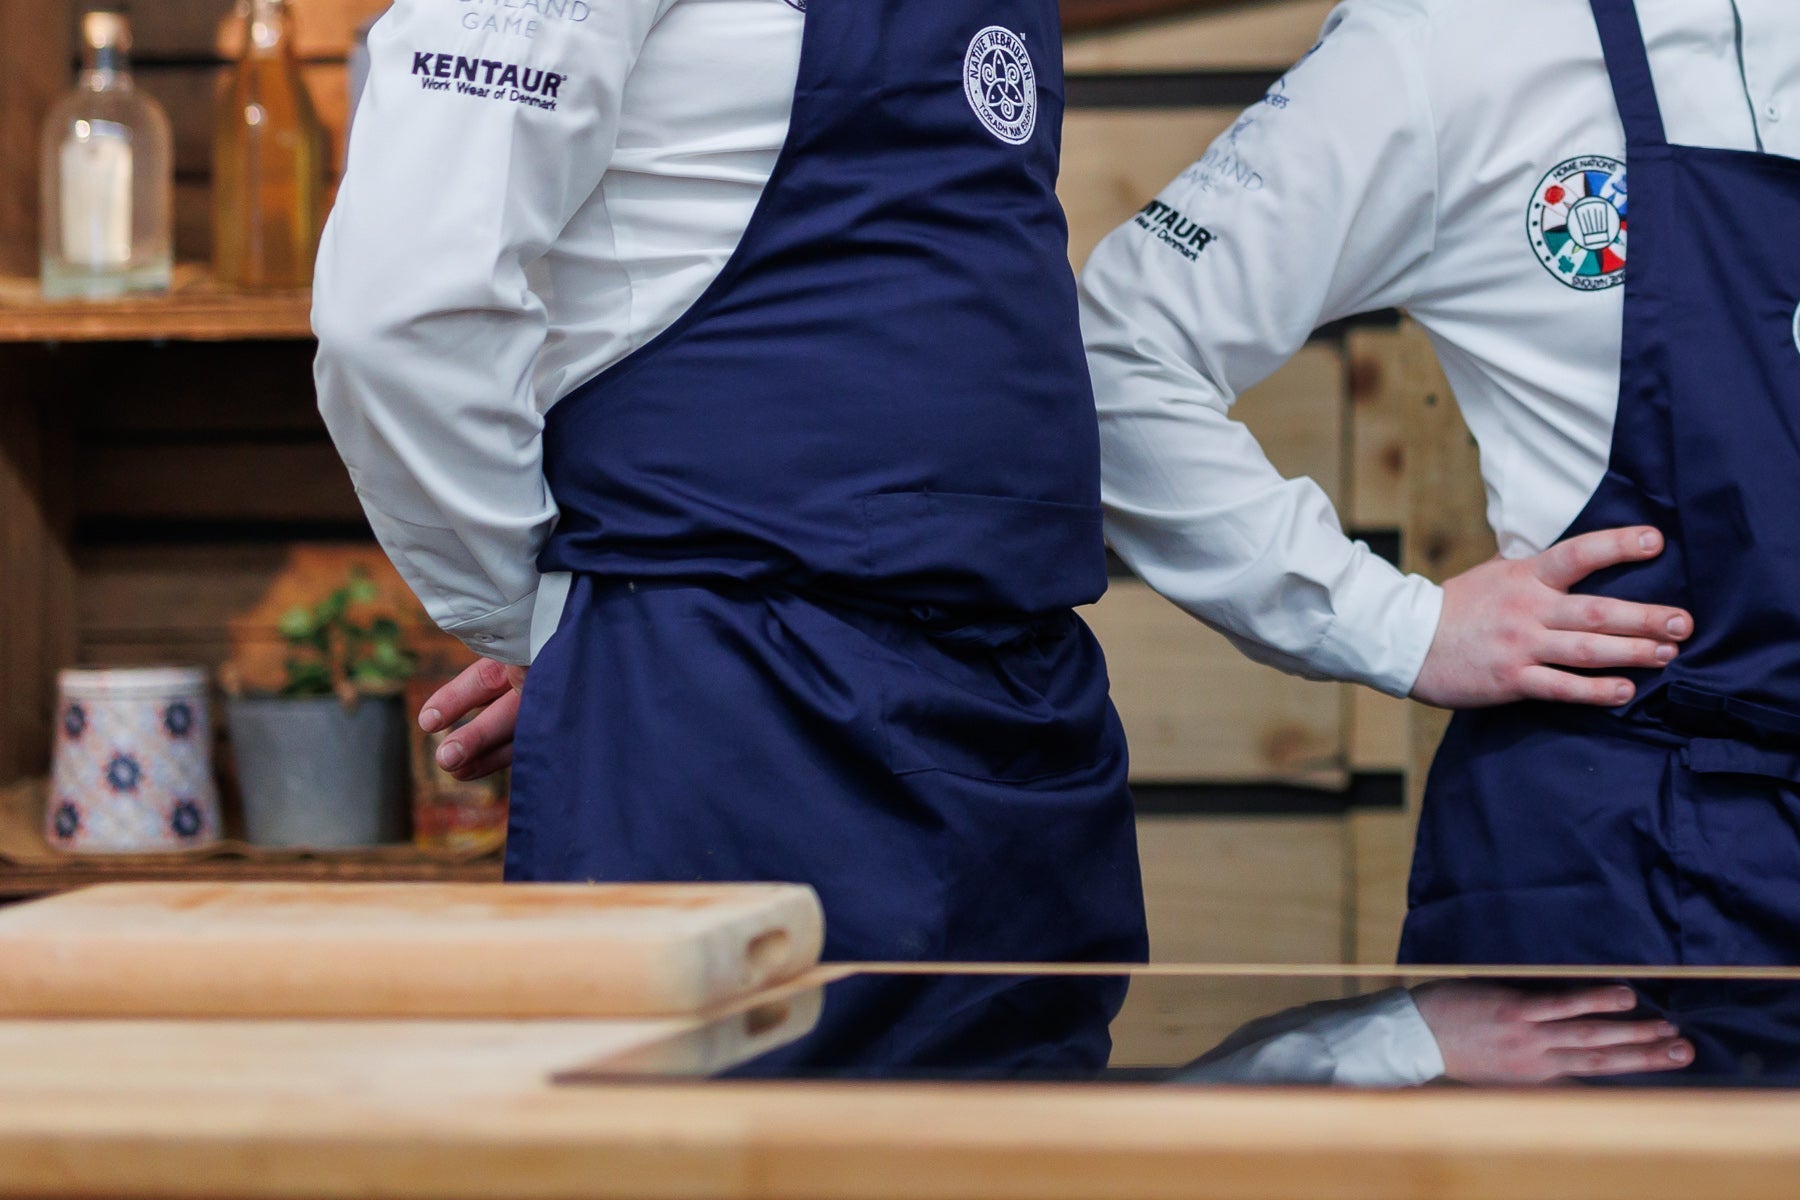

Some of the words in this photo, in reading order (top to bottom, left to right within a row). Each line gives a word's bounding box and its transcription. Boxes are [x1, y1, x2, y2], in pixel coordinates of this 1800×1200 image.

[461, 11, 539, 40] GAME
[970, 39, 988, 80] NATIVE
[988, 31, 1033, 81] HEBRIDEAN
[422, 76, 451, 91] Work
[456, 81, 490, 98] Wear
[493, 88, 506, 100] of
[509, 89, 557, 112] Denmark
[1553, 161, 1579, 180] HOME
[1579, 157, 1617, 173] NATIONS
